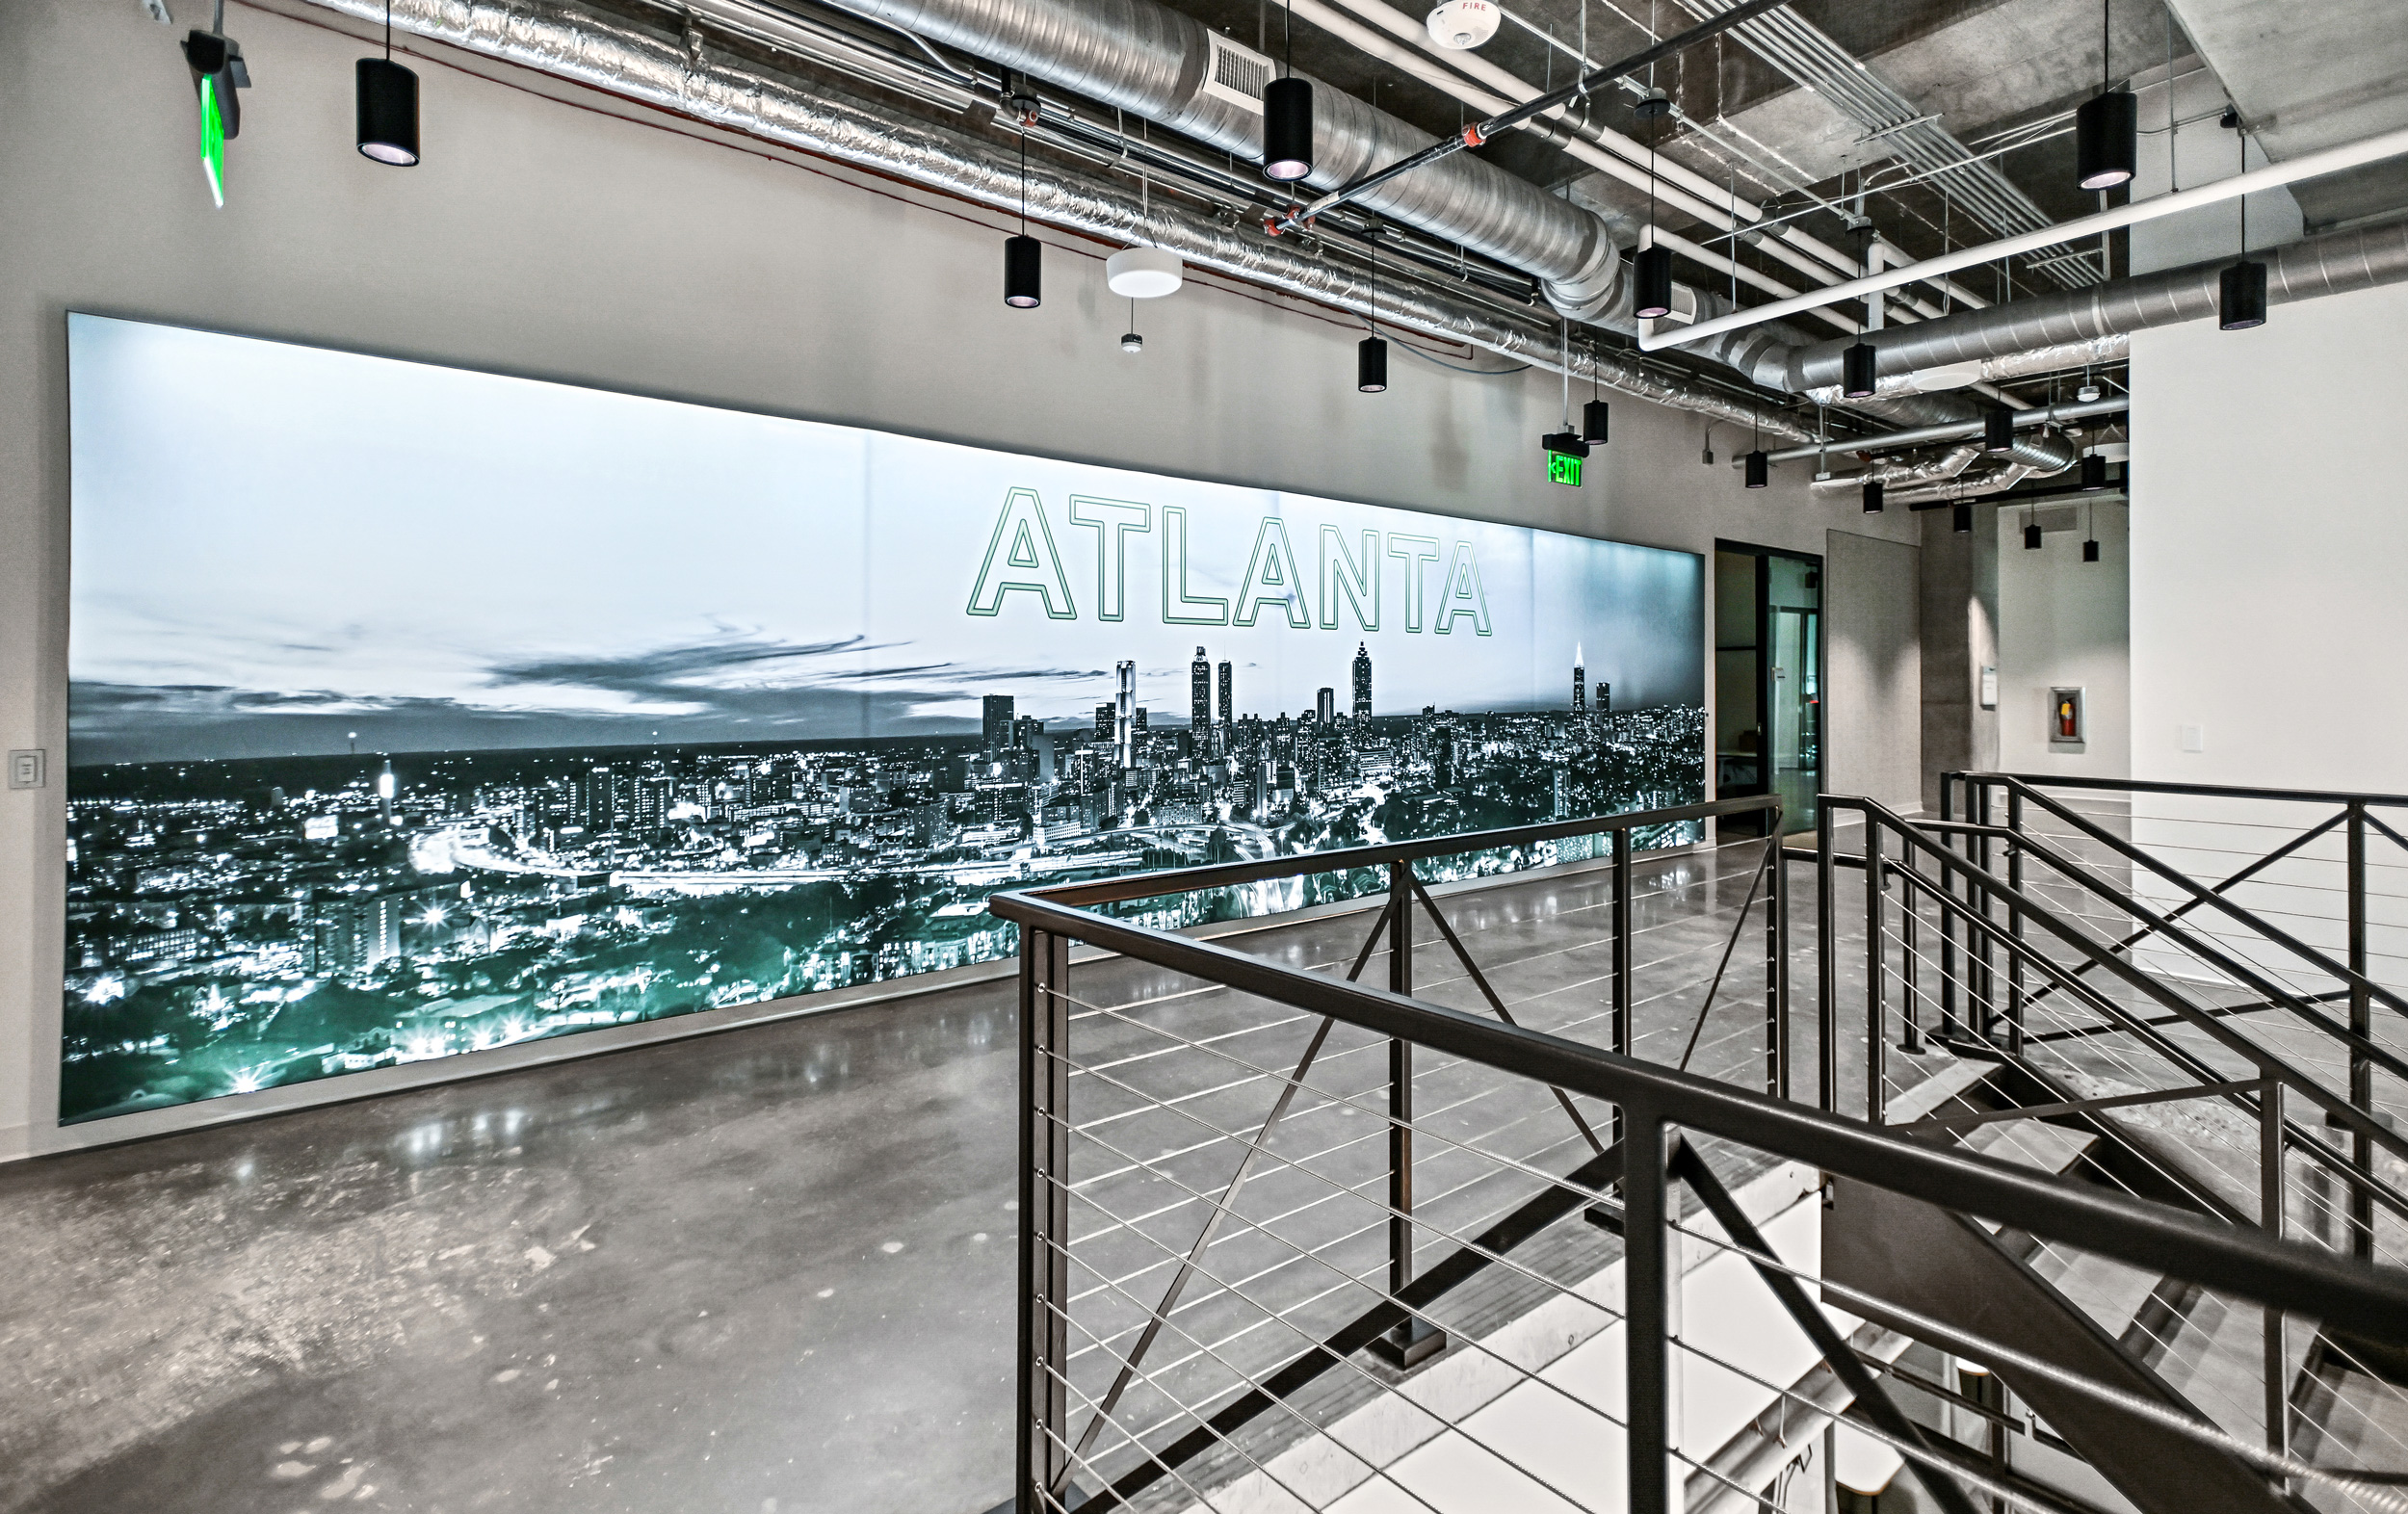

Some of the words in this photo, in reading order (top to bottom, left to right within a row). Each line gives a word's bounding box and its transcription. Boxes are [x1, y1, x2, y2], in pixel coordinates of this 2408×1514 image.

[1462, 2, 1486, 12] FIRE
[1555, 455, 1582, 486] EXIT
[966, 486, 1492, 637] ATLANTA
